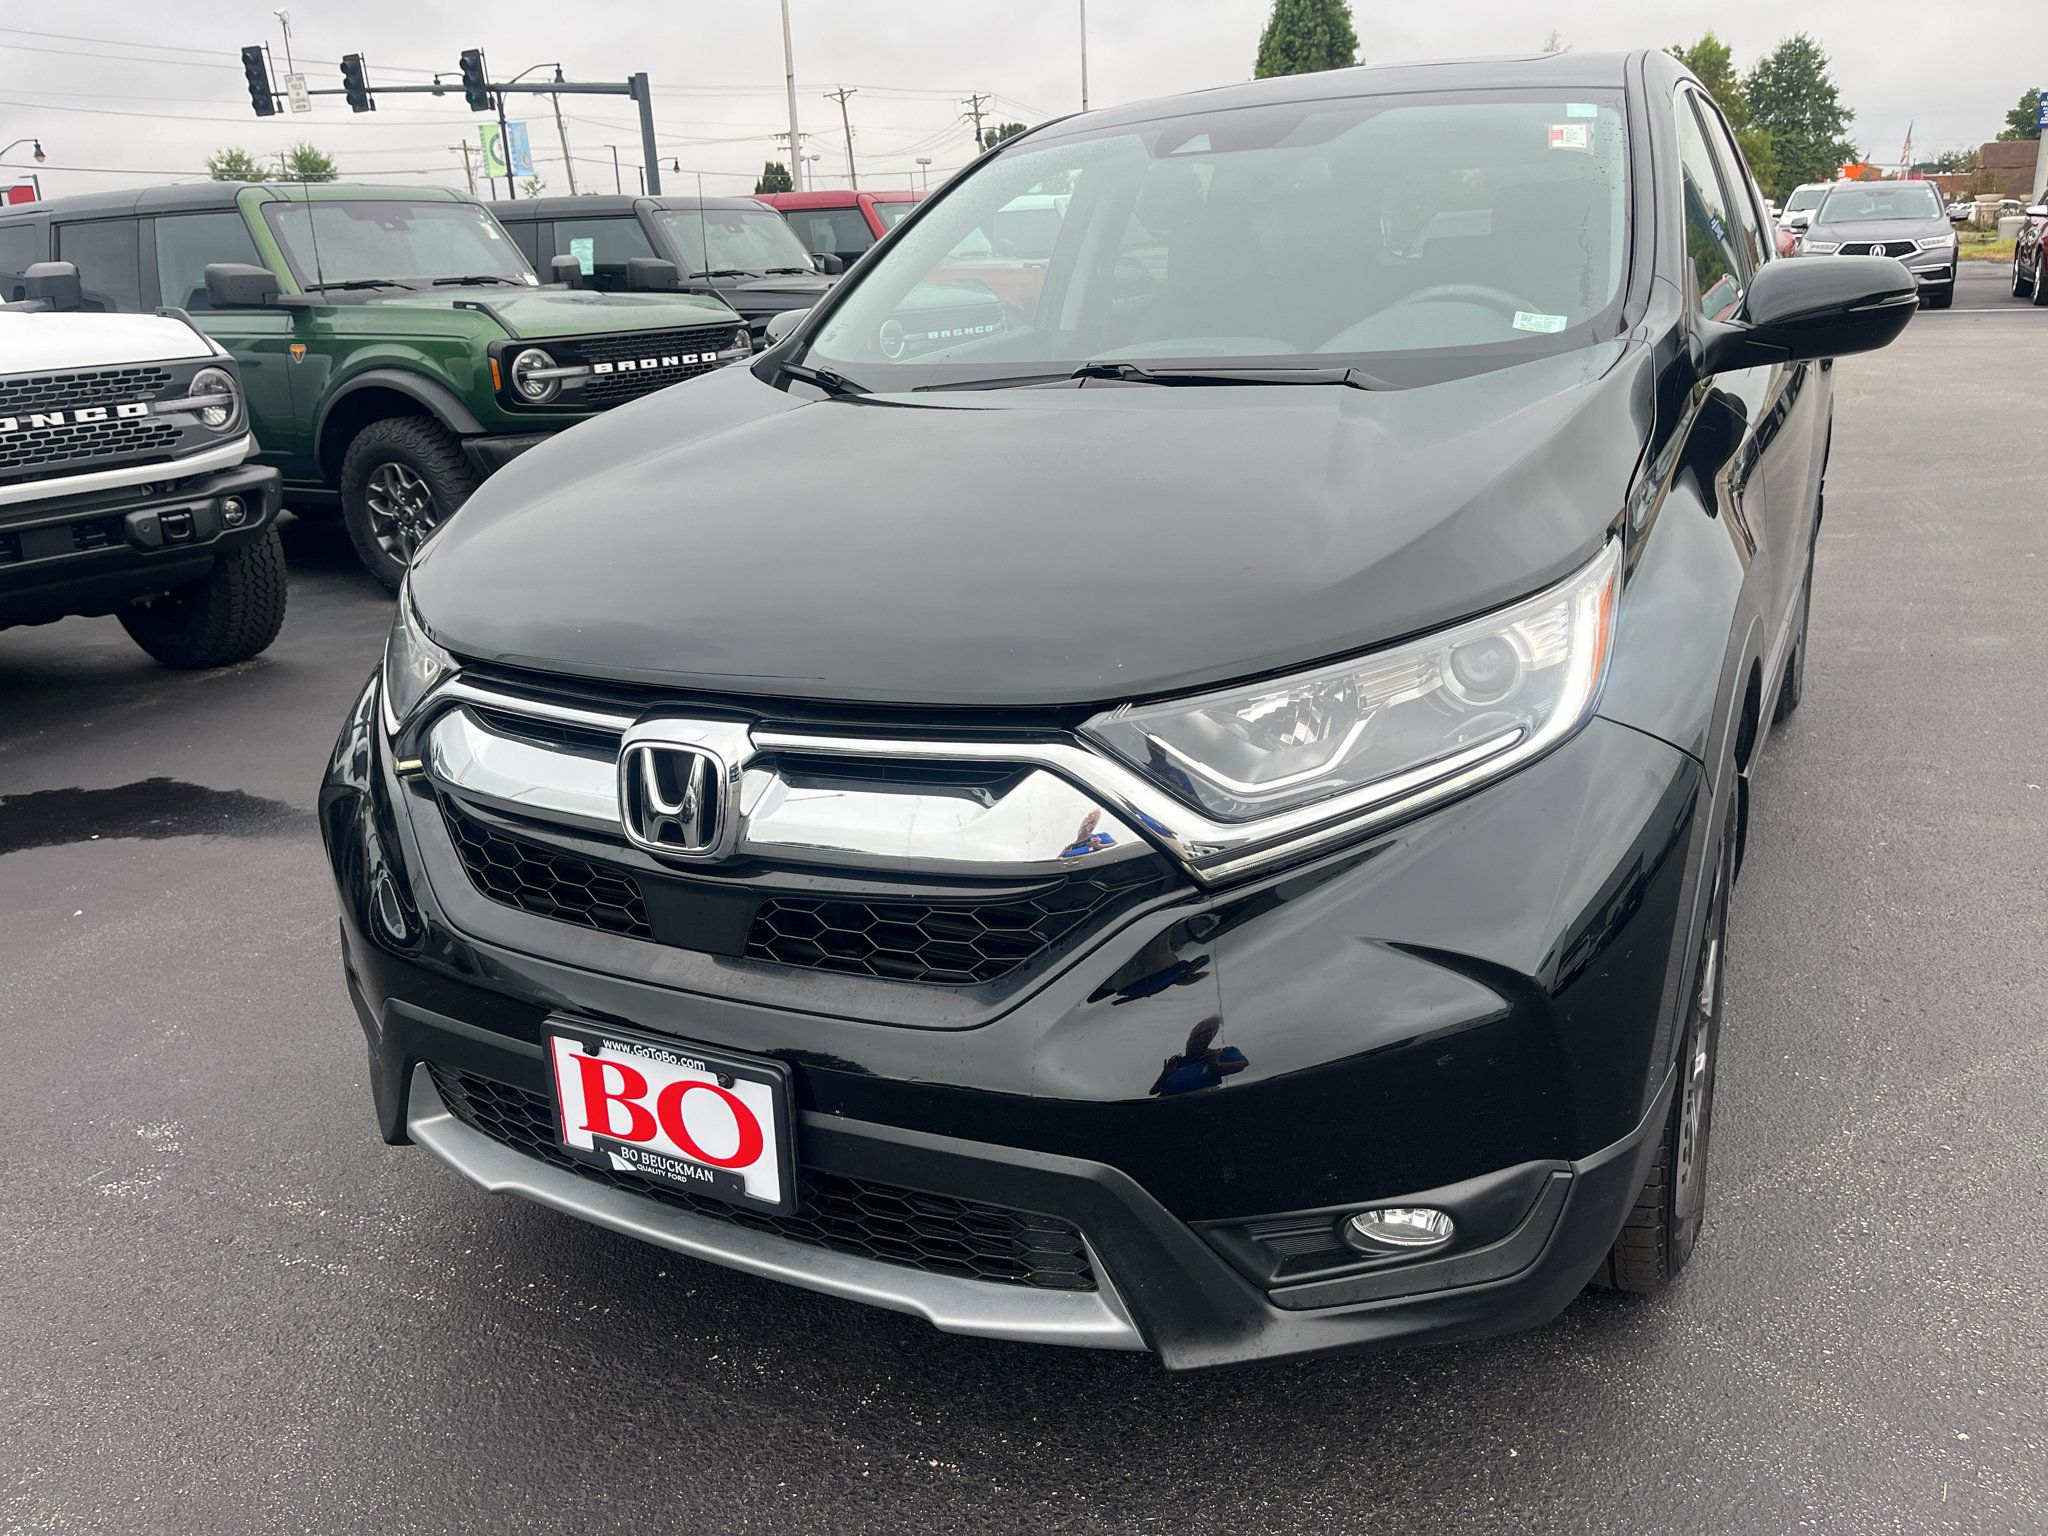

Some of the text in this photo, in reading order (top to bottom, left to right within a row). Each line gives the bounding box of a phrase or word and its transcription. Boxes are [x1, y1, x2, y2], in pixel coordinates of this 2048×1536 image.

[594, 352, 717, 374] BRONCO
[602, 1039, 706, 1071] www.GoToBo.com
[568, 1053, 764, 1169] BO
[620, 1146, 714, 1183] BO BEUCKMAN
[636, 1163, 687, 1183] QUALITY FORD
